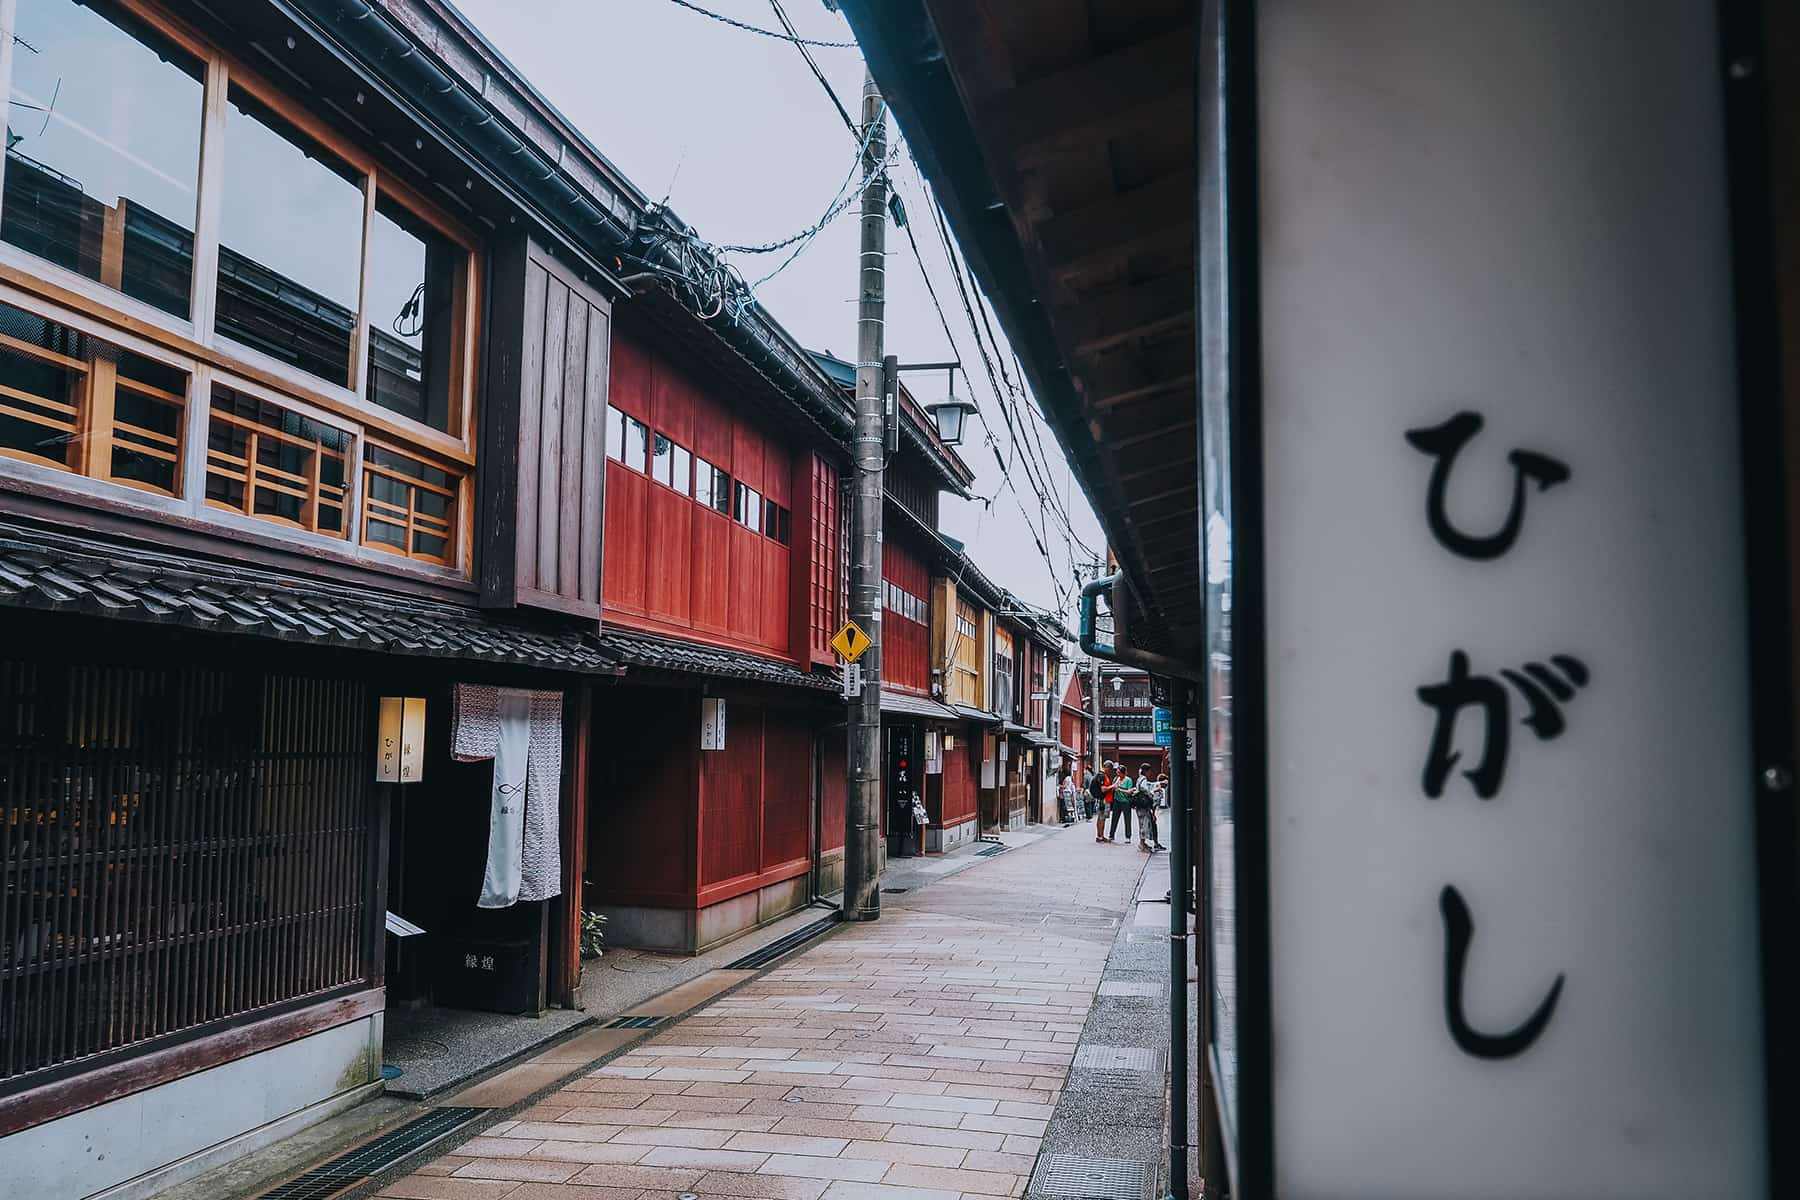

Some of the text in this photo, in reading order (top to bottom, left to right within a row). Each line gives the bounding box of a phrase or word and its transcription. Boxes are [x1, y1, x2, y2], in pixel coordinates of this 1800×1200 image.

[384, 738, 394, 775] ひがし
[1405, 410, 1591, 1060] ひがし
